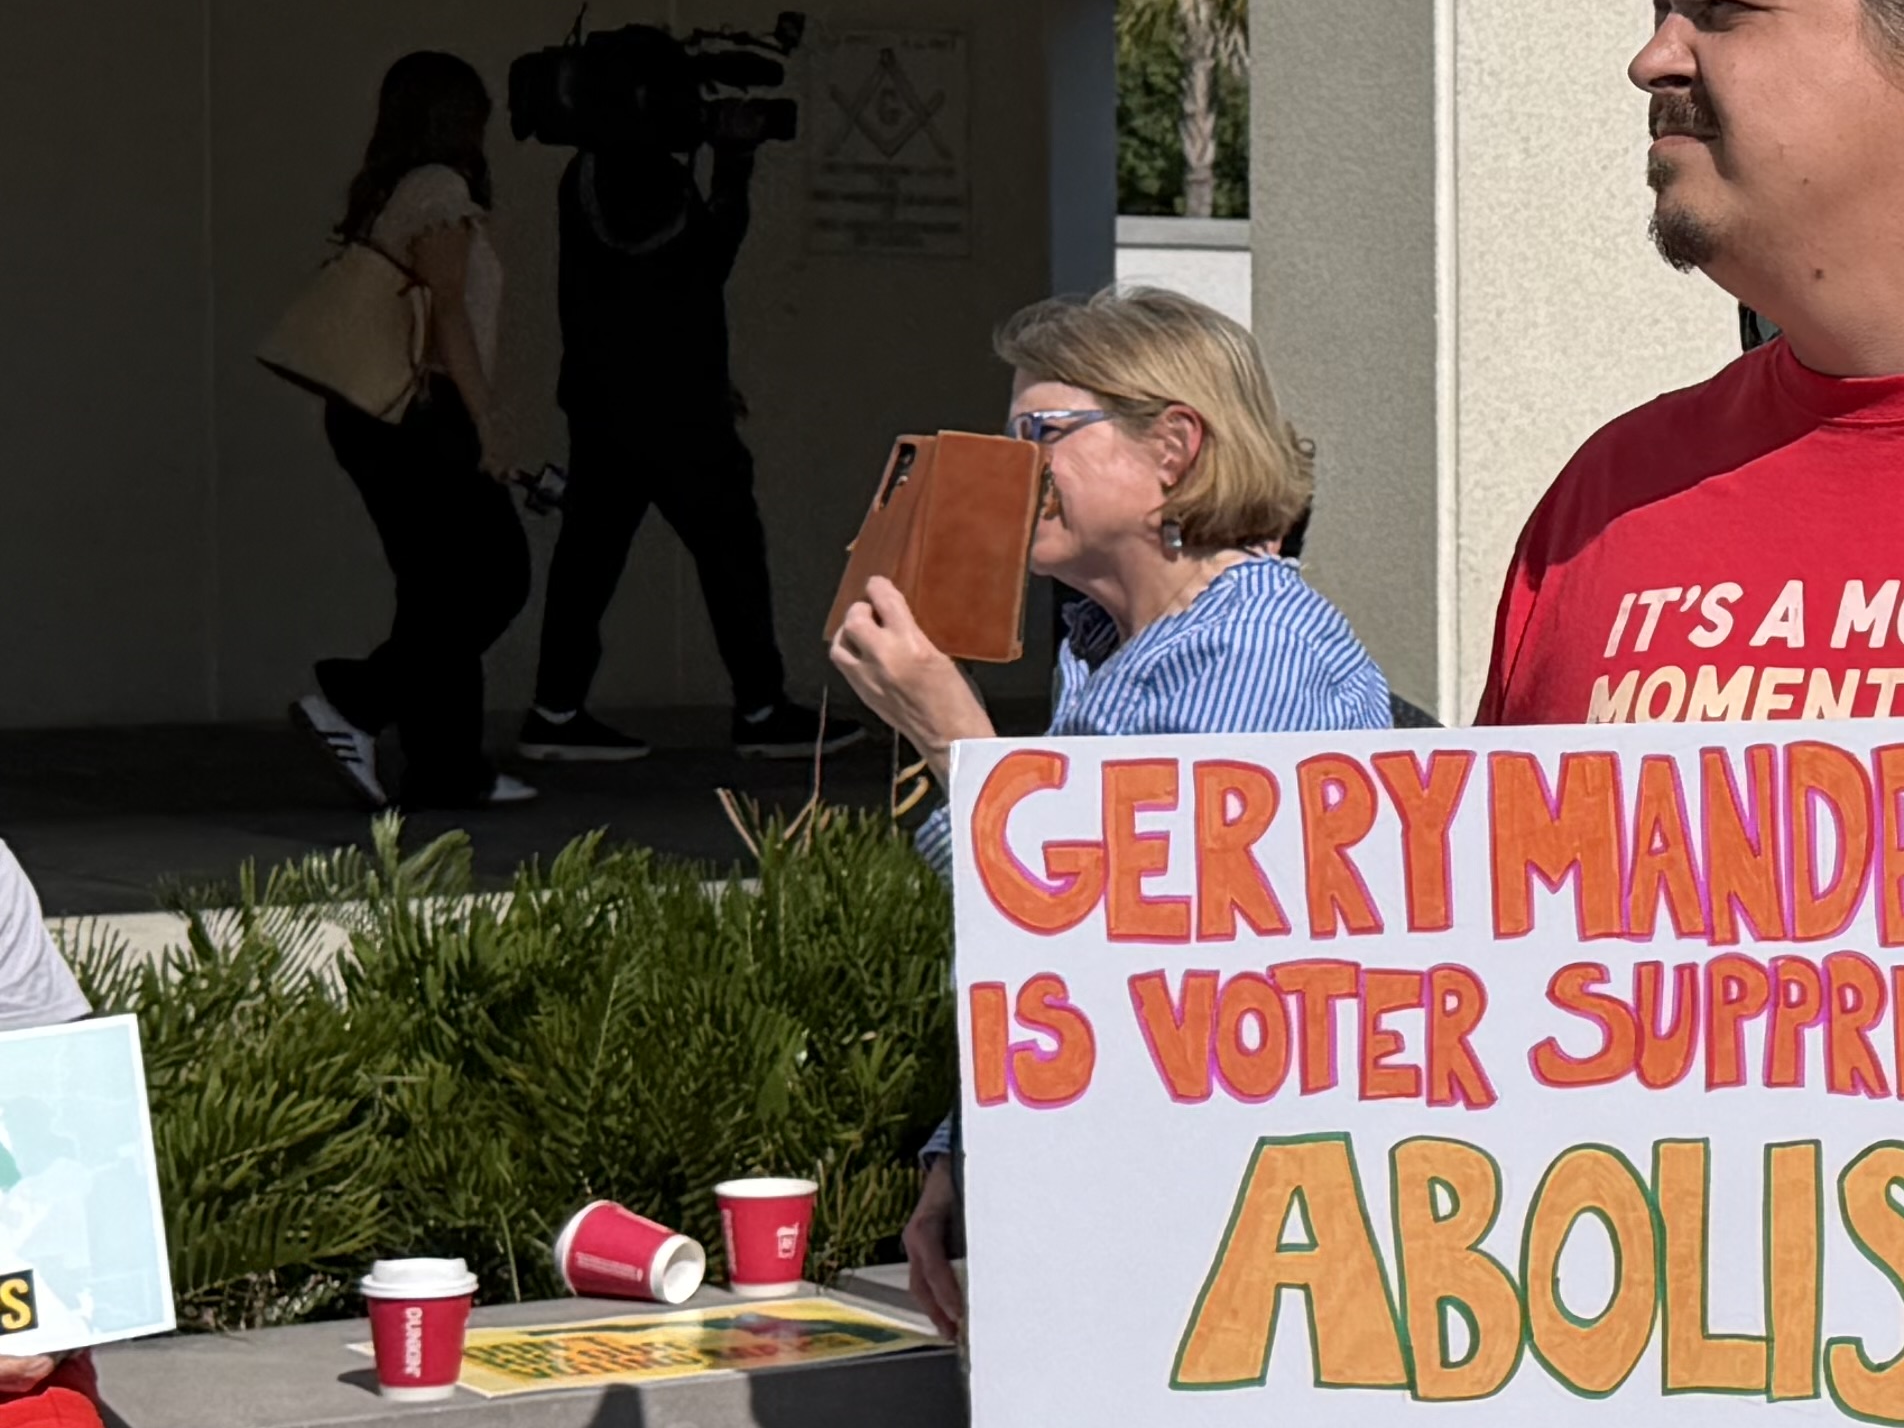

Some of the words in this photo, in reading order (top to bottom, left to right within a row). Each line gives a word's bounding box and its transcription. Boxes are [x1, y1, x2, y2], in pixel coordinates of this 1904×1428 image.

[1603, 582, 1743, 659] IT'S
[1749, 579, 1806, 650] A
[970, 974, 1094, 1107] IS
[1130, 962, 1497, 1109] VOTER
